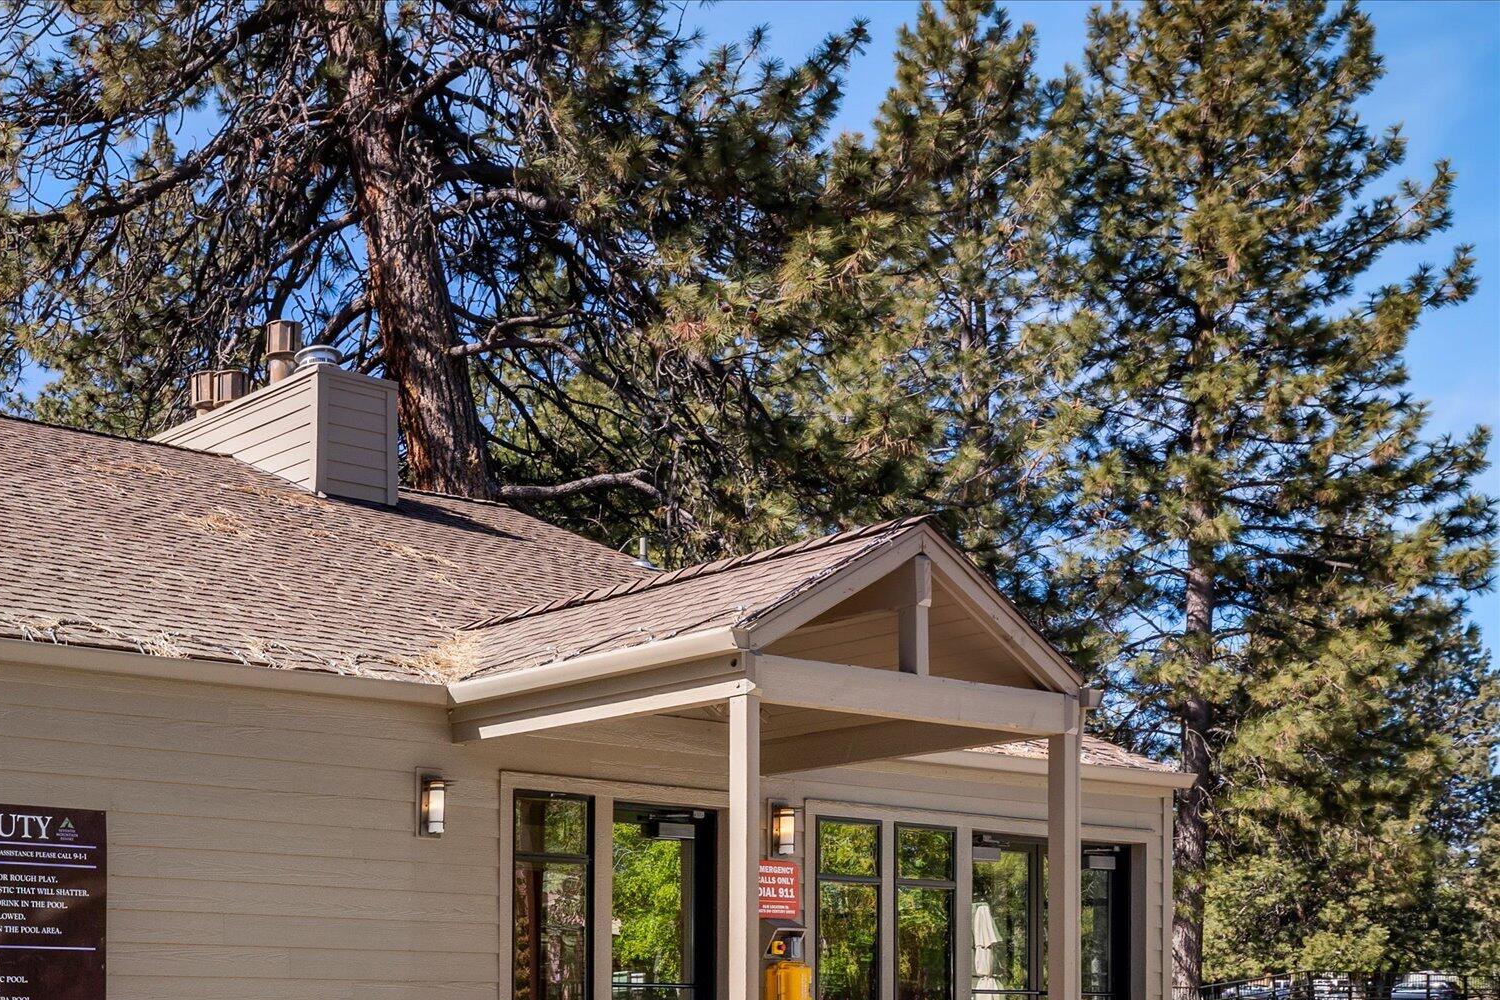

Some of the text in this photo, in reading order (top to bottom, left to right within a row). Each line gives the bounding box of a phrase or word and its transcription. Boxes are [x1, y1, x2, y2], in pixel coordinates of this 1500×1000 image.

[759, 865, 794, 874] MERGENCY
[38, 874, 57, 882] PLAY.
[777, 877, 794, 885] ONLY
[56, 888, 89, 896] SHATTER.
[759, 887, 795, 898] DIAL 911
[21, 900, 28, 908] IN
[30, 900, 45, 908] THE
[46, 900, 67, 909] POOL.
[4, 925, 18, 933] THE
[20, 925, 39, 933] POOL
[41, 926, 62, 934] AREA.
